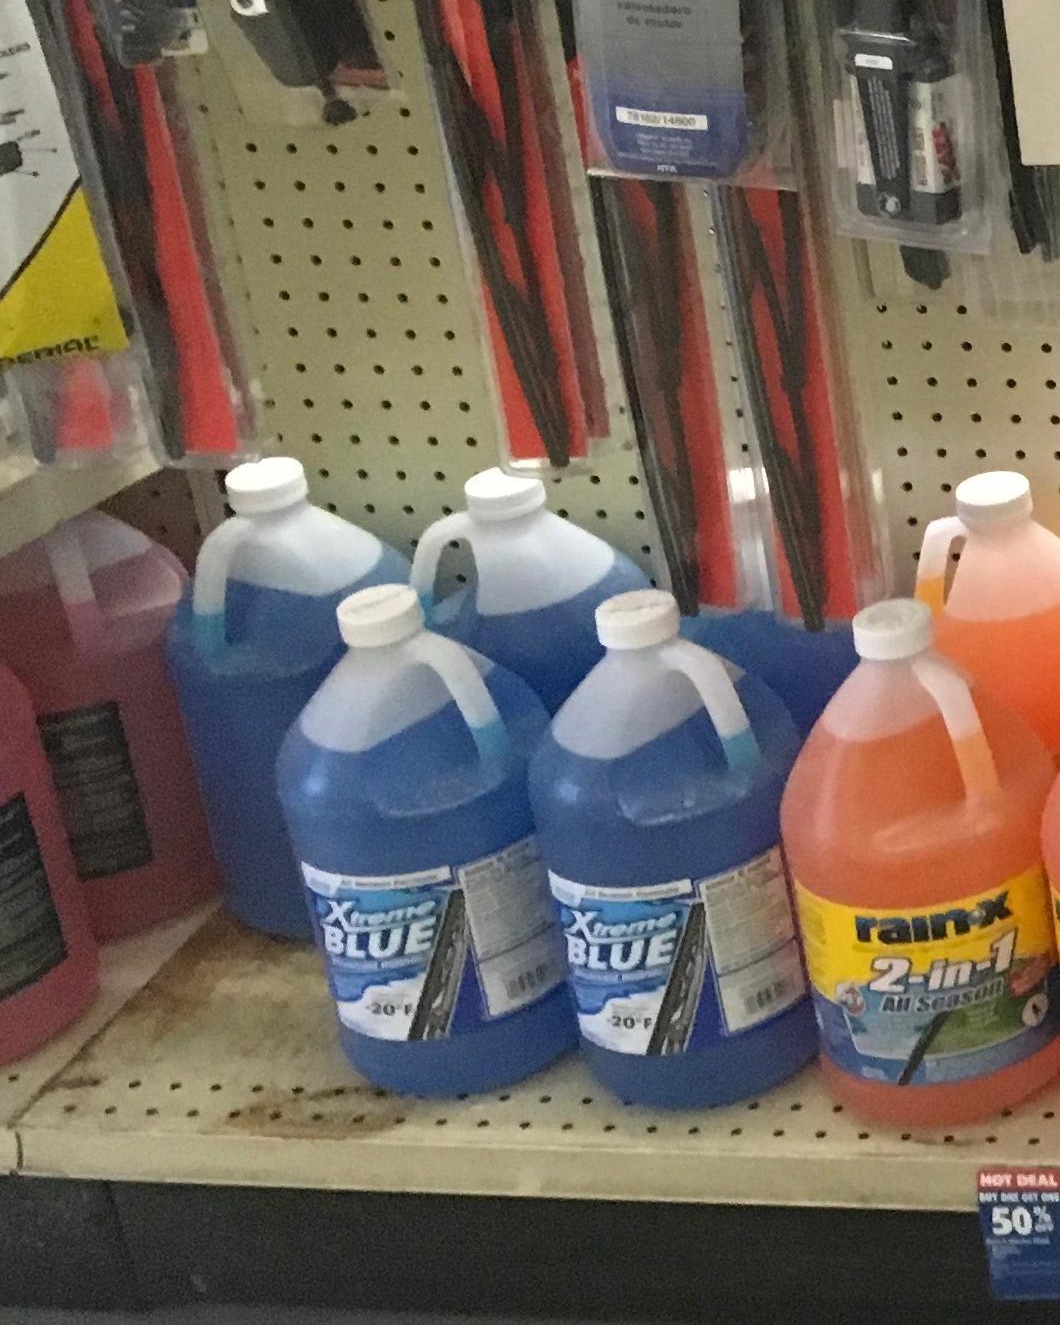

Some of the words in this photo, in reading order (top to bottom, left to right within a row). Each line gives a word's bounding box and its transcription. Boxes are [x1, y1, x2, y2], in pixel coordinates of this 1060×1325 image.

[324, 899, 437, 929] Xtreme
[568, 909, 677, 937] Xtreme
[322, 925, 436, 961] BLUE
[567, 930, 677, 972] BLUE
[869, 928, 1018, 994] 2-in-1
[980, 1173, 1013, 1187] HOT
[1016, 1173, 1058, 1187] DEAL
